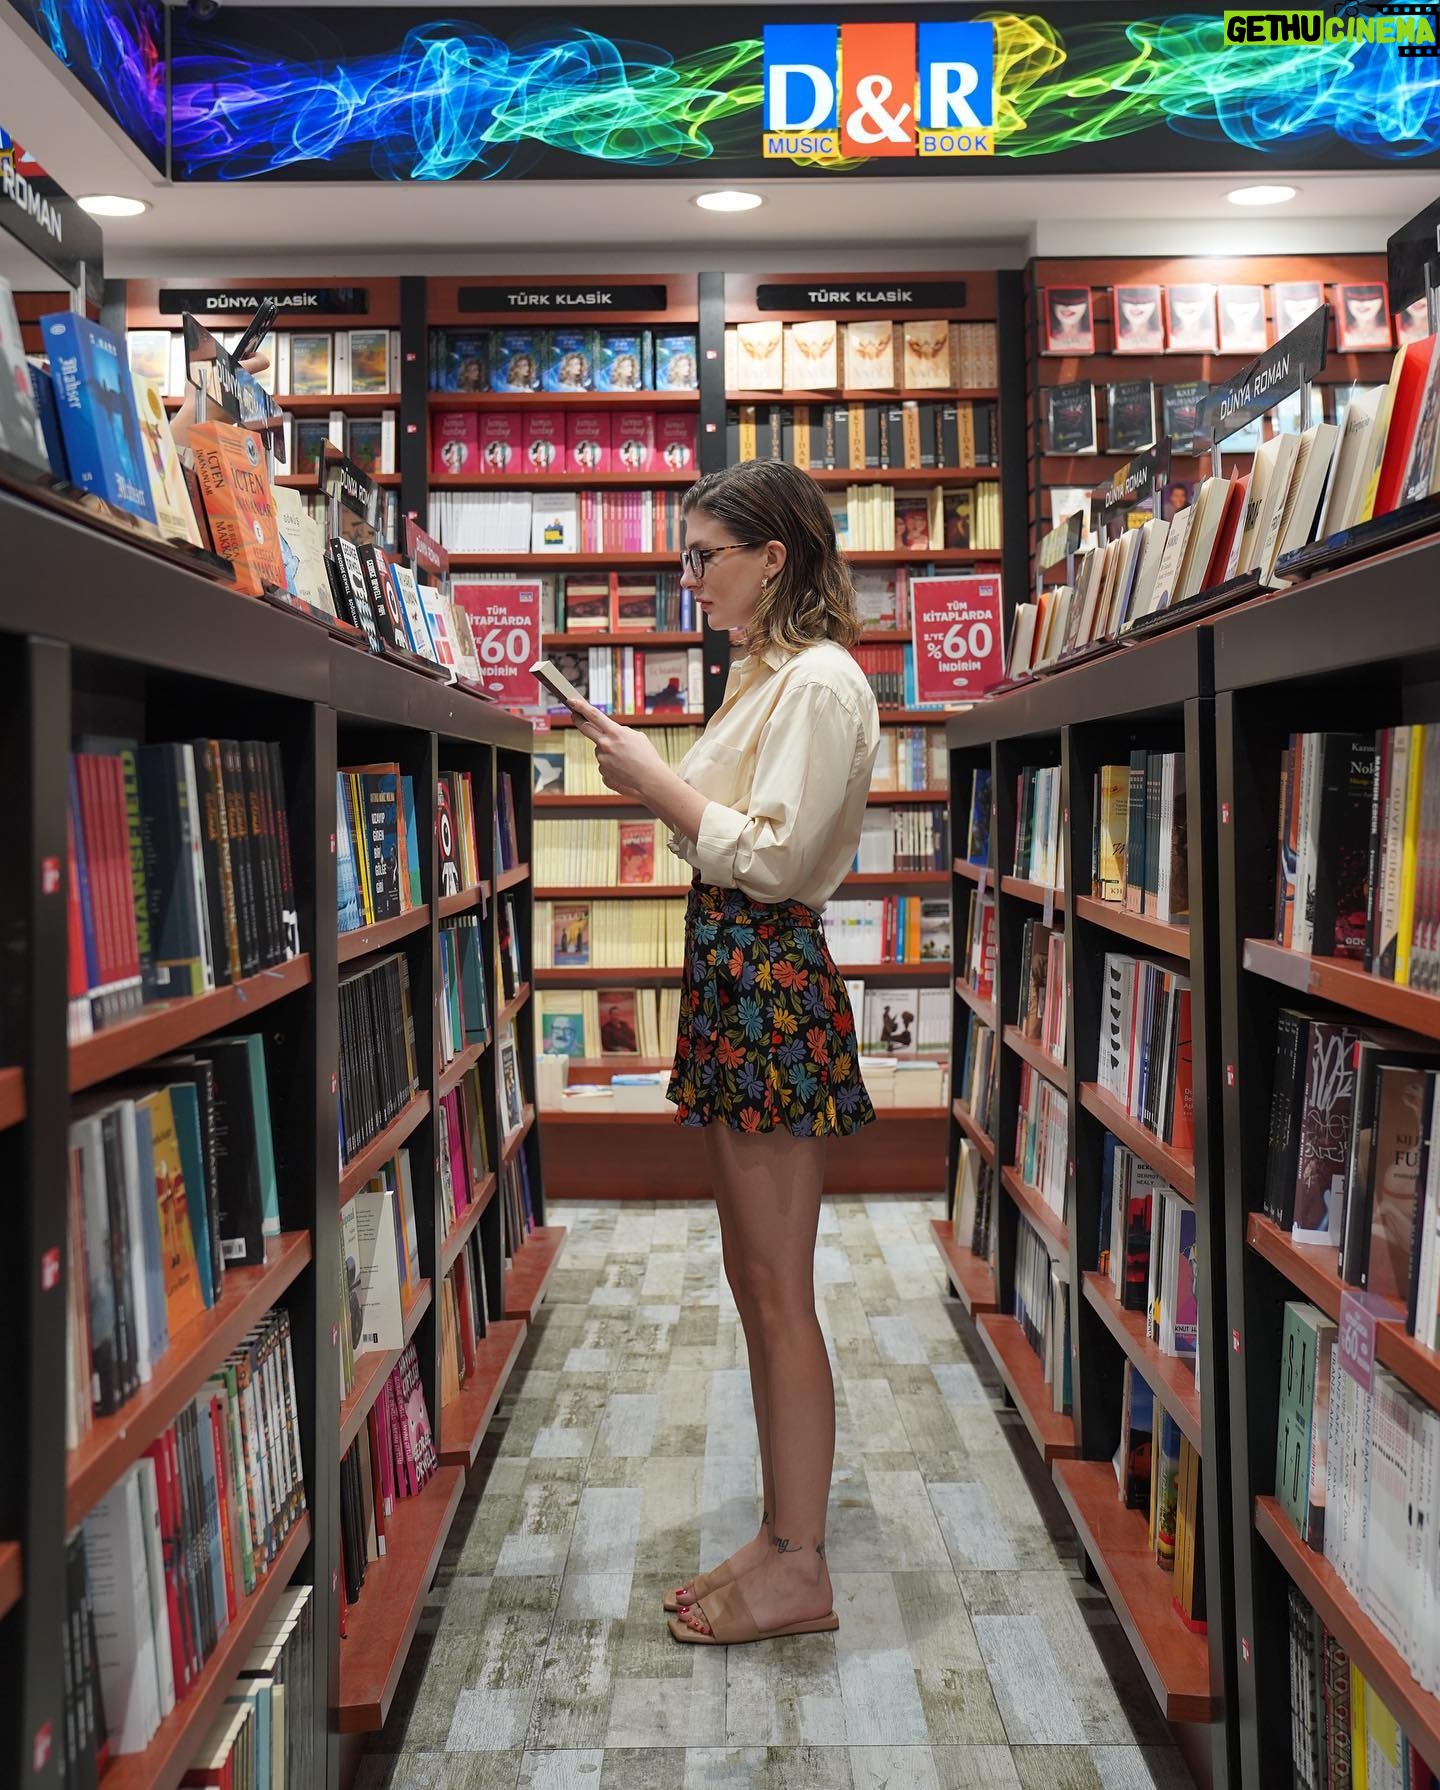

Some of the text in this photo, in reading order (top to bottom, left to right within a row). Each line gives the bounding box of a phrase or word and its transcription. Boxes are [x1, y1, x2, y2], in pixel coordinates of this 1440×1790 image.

[768, 137, 833, 154] MUSIC
[924, 135, 988, 151] BOOK
[3, 160, 63, 243] ROMAN
[206, 295, 258, 309] DÜNYA
[508, 291, 613, 306] TÜRK KLASİK
[808, 288, 913, 303] TÜRK KLASİK
[1220, 354, 1290, 421] DÜNYA ROMAN
[1125, 465, 1148, 495] ROMAN
[486, 605, 507, 615] TÜM
[946, 600, 968, 611] TÜM
[469, 614, 532, 626] İTAPLARDA
[923, 610, 993, 623] KİTAPLARDA
[481, 628, 531, 664] 60
[480, 664, 518, 677] NDİRİM
[939, 660, 982, 673] İNDİRİM
